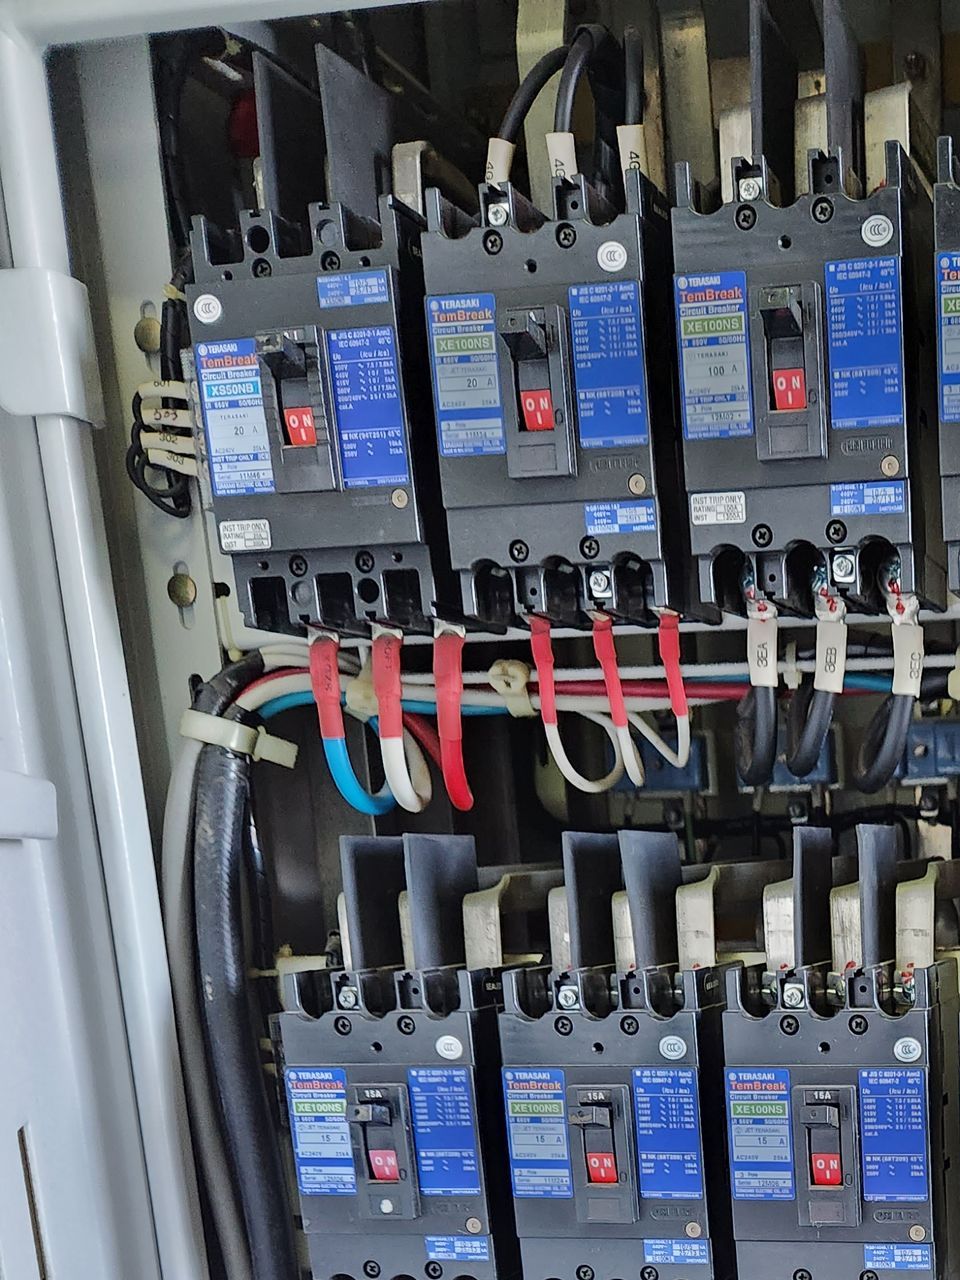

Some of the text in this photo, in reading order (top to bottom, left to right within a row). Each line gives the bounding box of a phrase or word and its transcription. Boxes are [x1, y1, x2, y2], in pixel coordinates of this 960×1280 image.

[688, 276, 720, 286] TERASAKI
[680, 286, 742, 303] TemBreak
[441, 299, 479, 308] TERASAKI
[680, 304, 739, 316] Circuit Breaker
[432, 309, 492, 322] TemBreak
[686, 317, 740, 332] XE100NS
[433, 325, 484, 334] Circuit Breaker
[208, 343, 237, 354] TERASAKI
[440, 337, 490, 351] XE100NS
[201, 354, 257, 368] TemBreak
[202, 370, 256, 380] Circuit Breaker
[708, 367, 724, 376] 100
[467, 379, 477, 388] 20
[211, 383, 253, 396] XS50NB
[234, 426, 244, 435] 20
[757, 642, 767, 667] 3EA
[825, 647, 836, 673] 3EB
[910, 652, 921, 679] 3EC
[298, 1072, 332, 1080] TERASAKI
[515, 1072, 549, 1080] TERASAKI
[292, 1080, 342, 1089] TemBreak
[508, 1081, 561, 1090] TemBreak
[731, 1081, 785, 1090] TemBreak
[366, 1090, 383, 1098] 15A
[587, 1092, 604, 1100] 15A
[299, 1103, 342, 1112] XE100NS
[514, 1104, 559, 1113] XE100NS
[736, 1105, 782, 1113] XE100NS
[758, 1137, 767, 1145] 15
